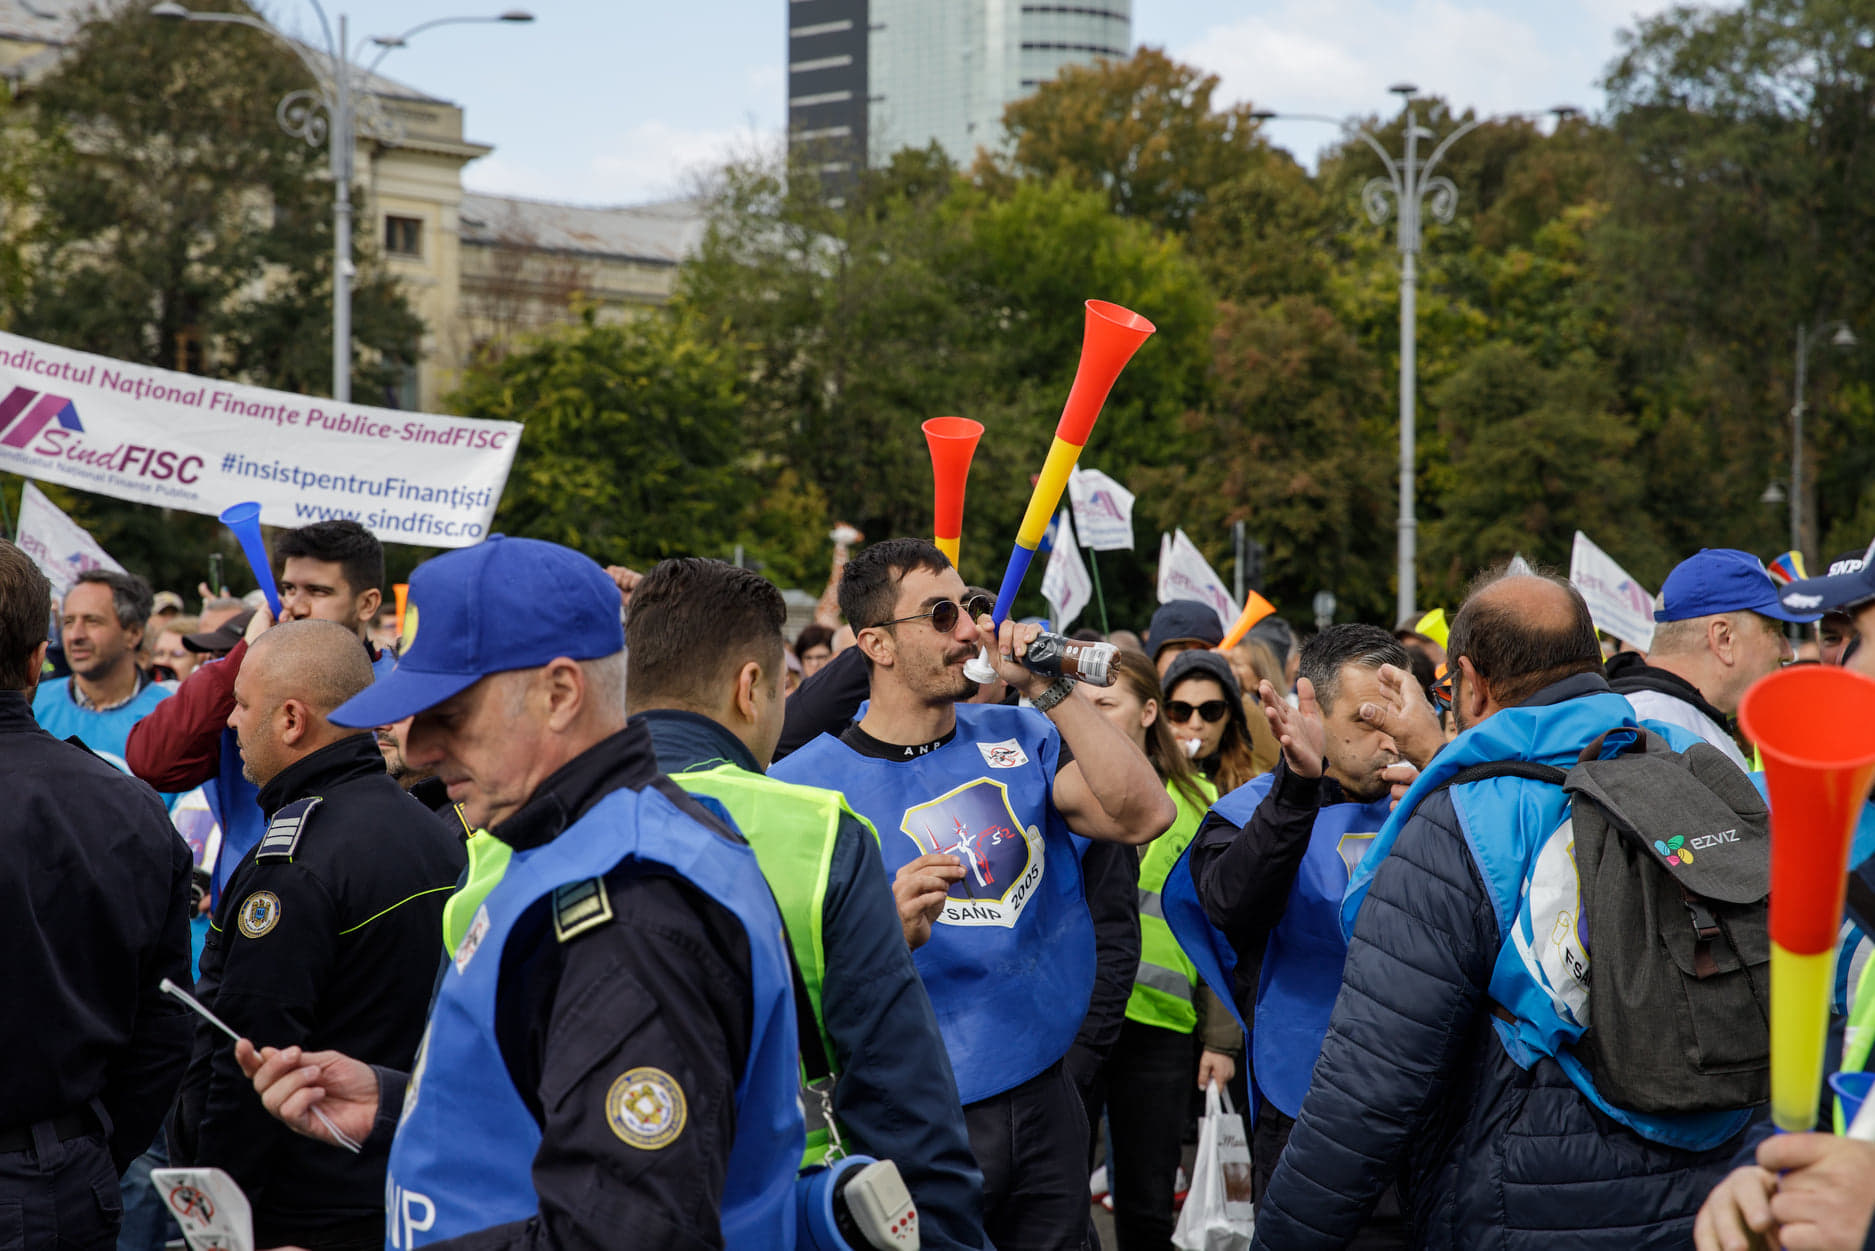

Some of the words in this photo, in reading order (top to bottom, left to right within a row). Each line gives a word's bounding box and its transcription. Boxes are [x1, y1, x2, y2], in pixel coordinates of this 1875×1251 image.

[306, 408, 509, 450] Publice-SindFISC
[34, 429, 205, 484] SindFISC
[1690, 829, 1741, 850] EZVIZ
[944, 907, 1002, 921] SANP
[1011, 863, 1039, 911] 2005
